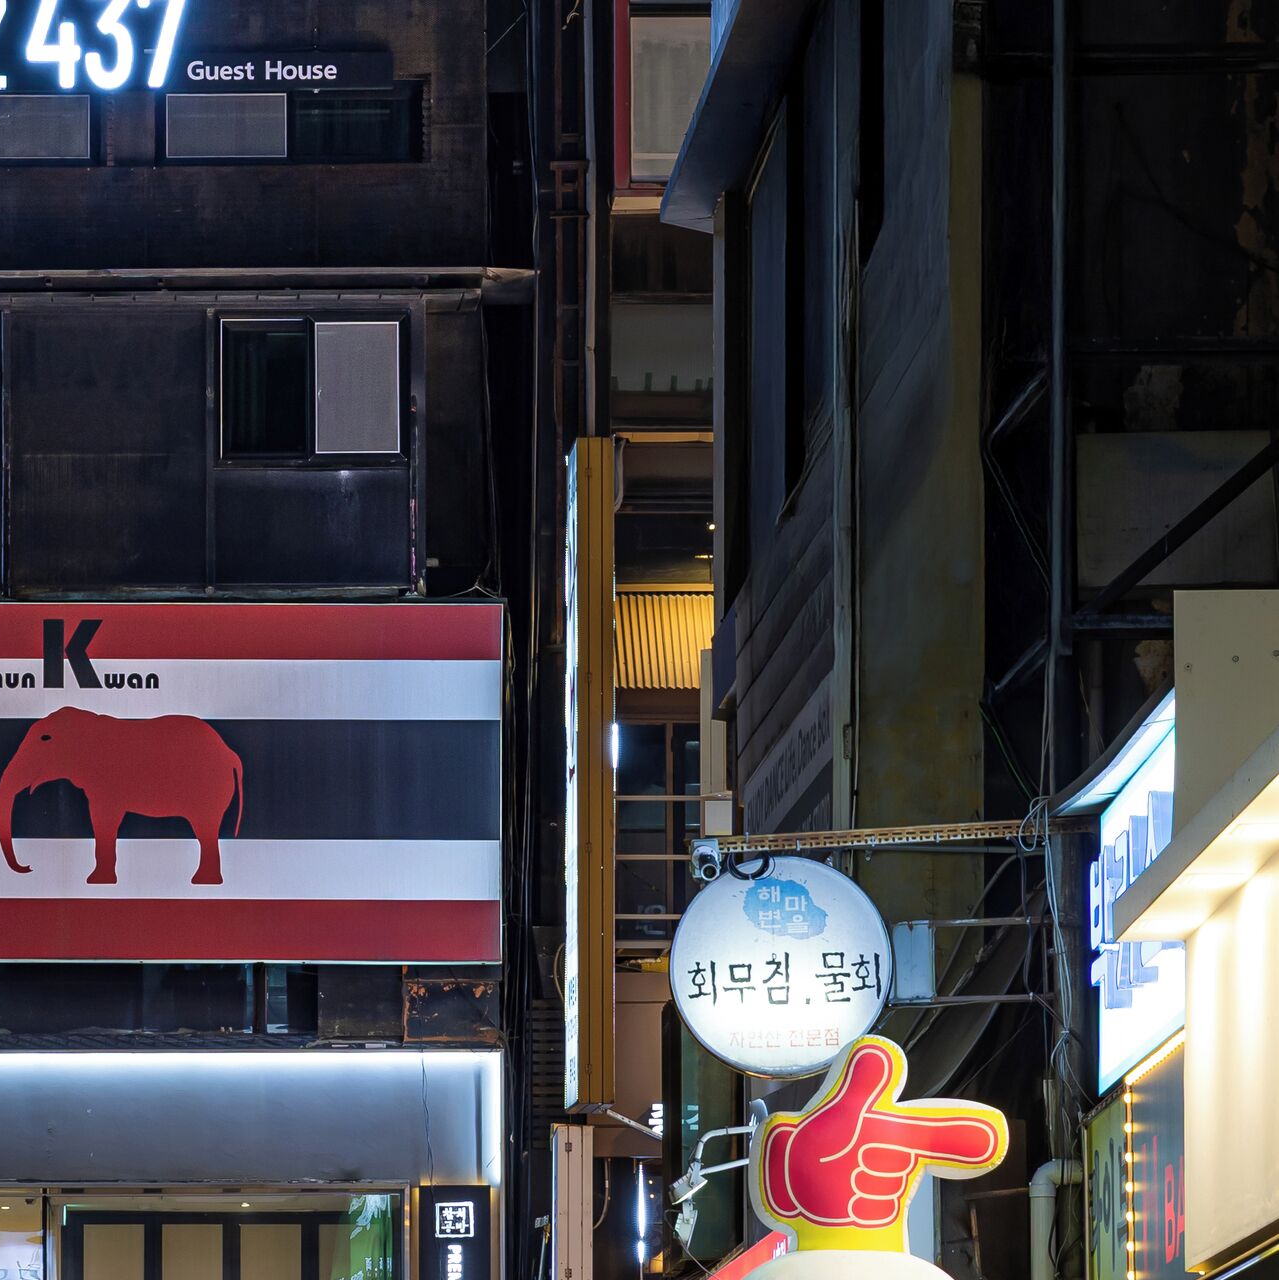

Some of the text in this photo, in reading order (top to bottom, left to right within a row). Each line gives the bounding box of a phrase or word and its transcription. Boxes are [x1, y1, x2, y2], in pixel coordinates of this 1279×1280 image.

[186, 59, 338, 82] Guest House
[43, 618, 160, 690] Kwan
[815, 951, 882, 1003] 물회
